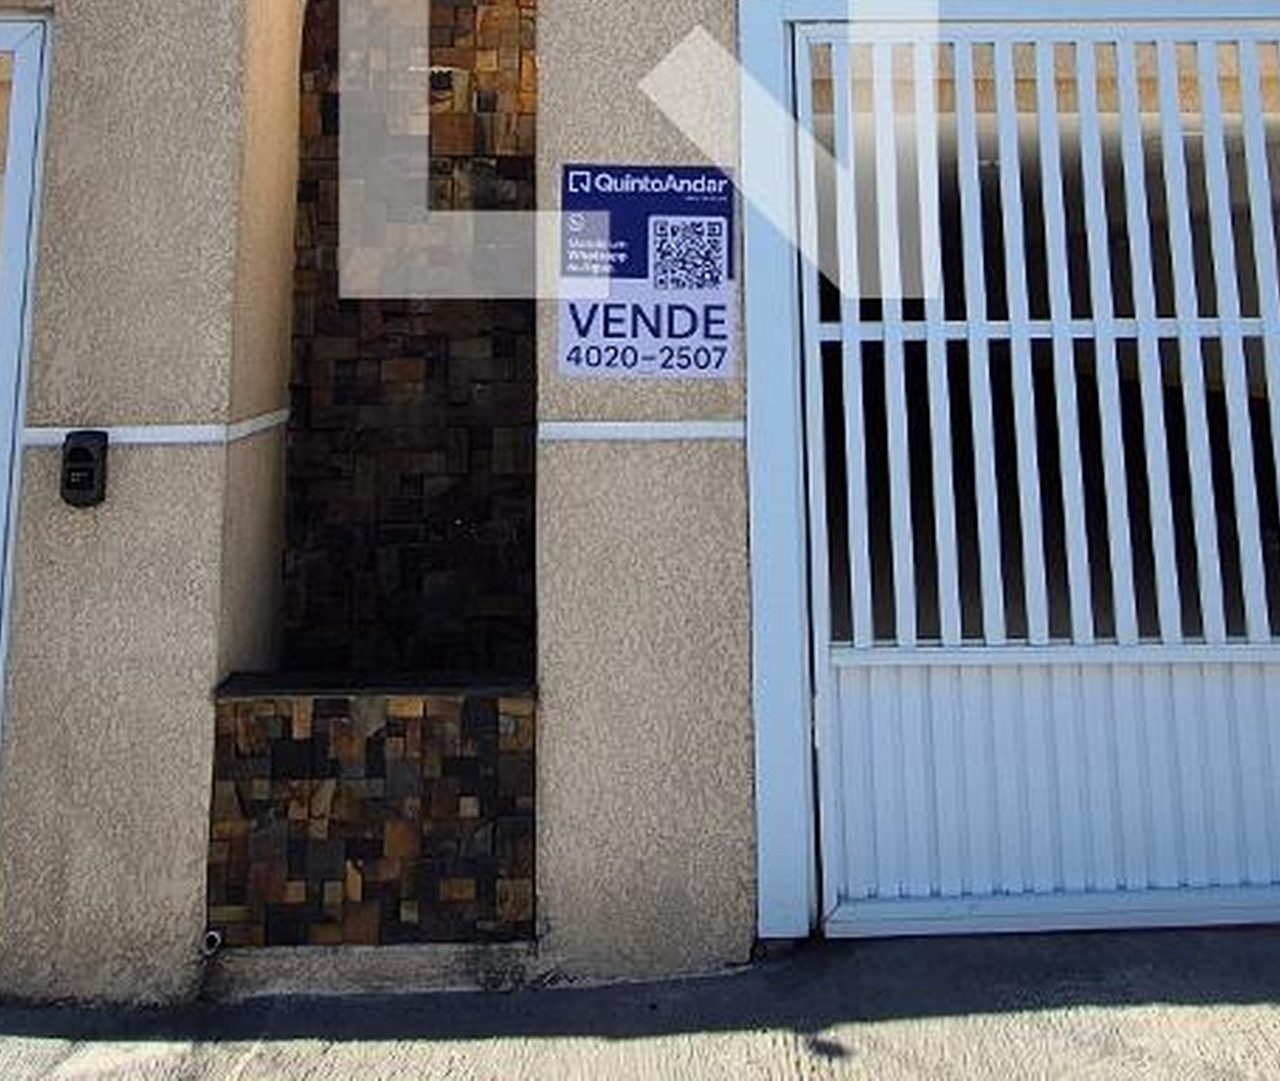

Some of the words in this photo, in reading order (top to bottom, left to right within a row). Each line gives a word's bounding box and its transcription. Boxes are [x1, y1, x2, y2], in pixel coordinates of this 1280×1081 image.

[594, 173, 728, 193] QuintoAndar
[568, 303, 728, 340] VENDE
[566, 345, 728, 370] 4020-2507
